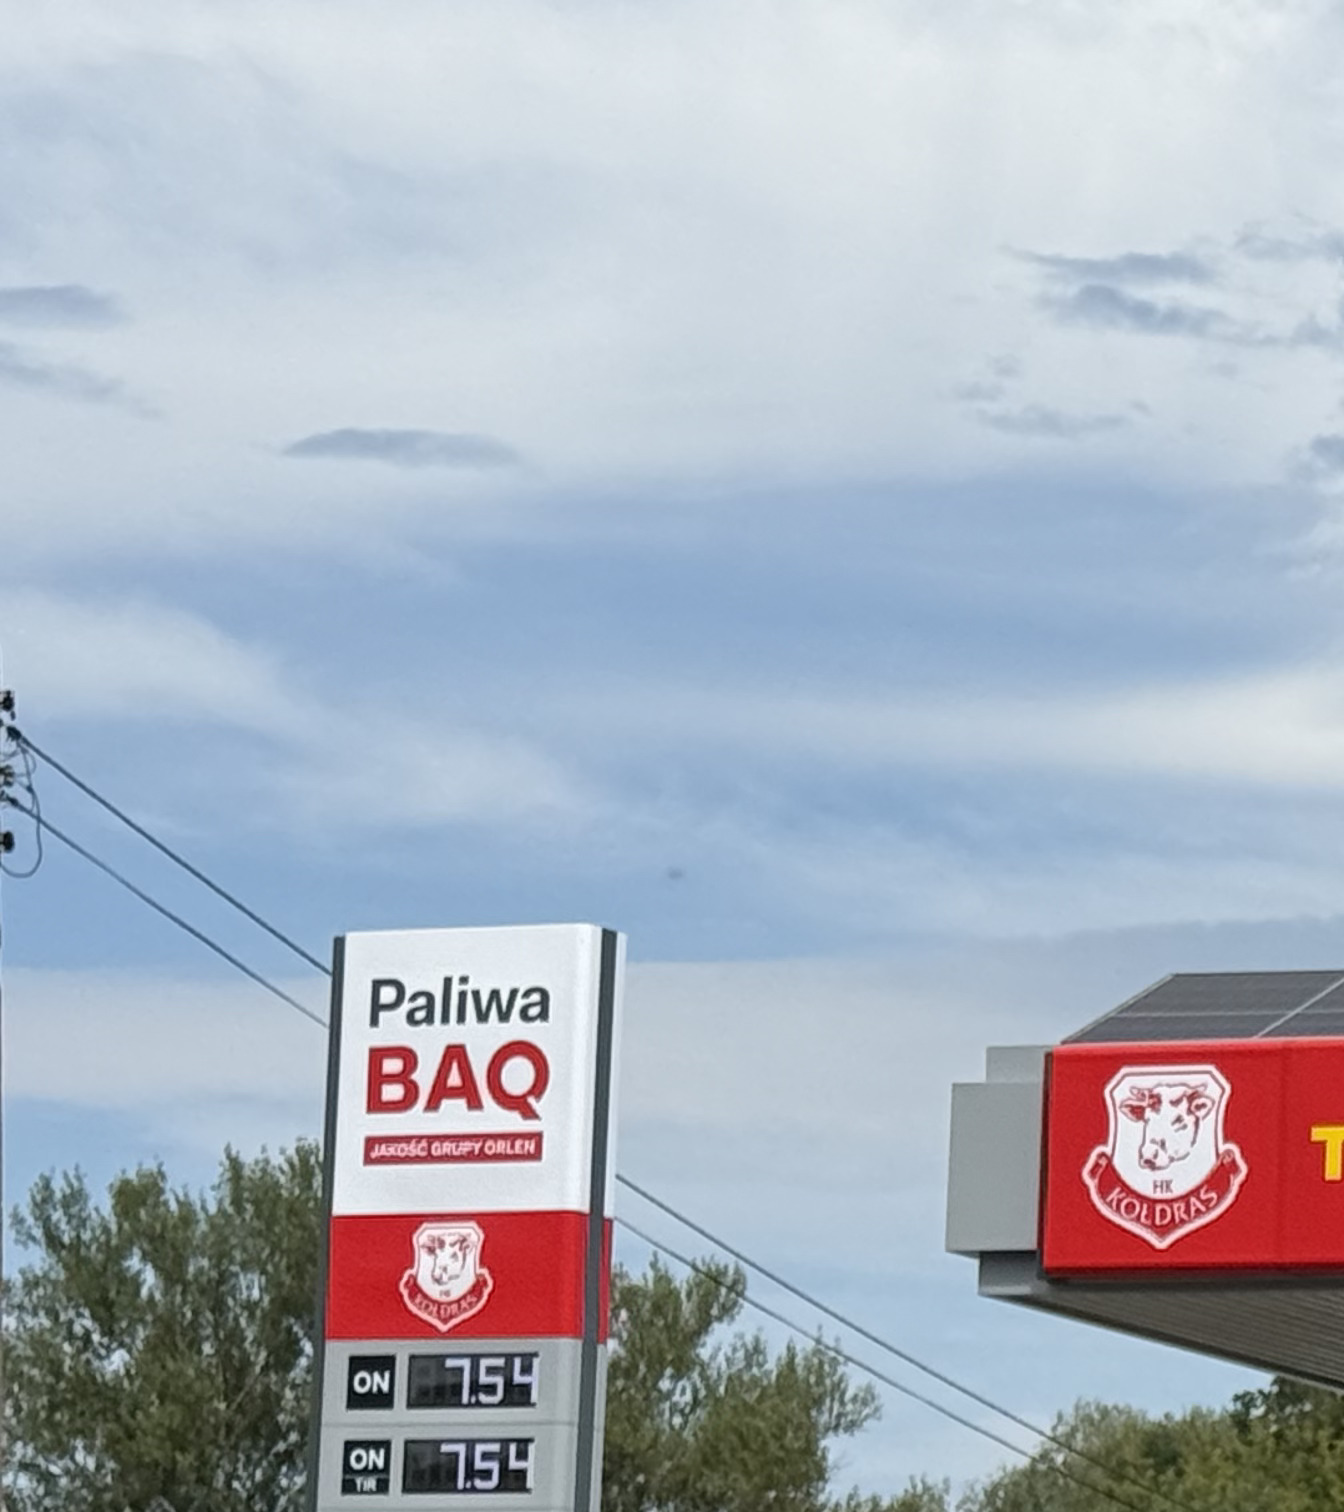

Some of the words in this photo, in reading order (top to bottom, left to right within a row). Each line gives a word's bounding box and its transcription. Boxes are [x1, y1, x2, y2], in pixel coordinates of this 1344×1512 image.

[370, 976, 550, 1027] Paliwa
[366, 1040, 550, 1120] BAQ
[370, 1139, 428, 1159] JAKOŚĆ
[431, 1139, 483, 1157] GRUPY
[484, 1138, 536, 1156] ORLEN
[1153, 1179, 1174, 1195] HK
[353, 1370, 390, 1394] ON
[445, 1357, 538, 1405] 7.54
[349, 1449, 385, 1470] ON
[440, 1442, 534, 1490] 7.54
[355, 1479, 377, 1492] TIR
